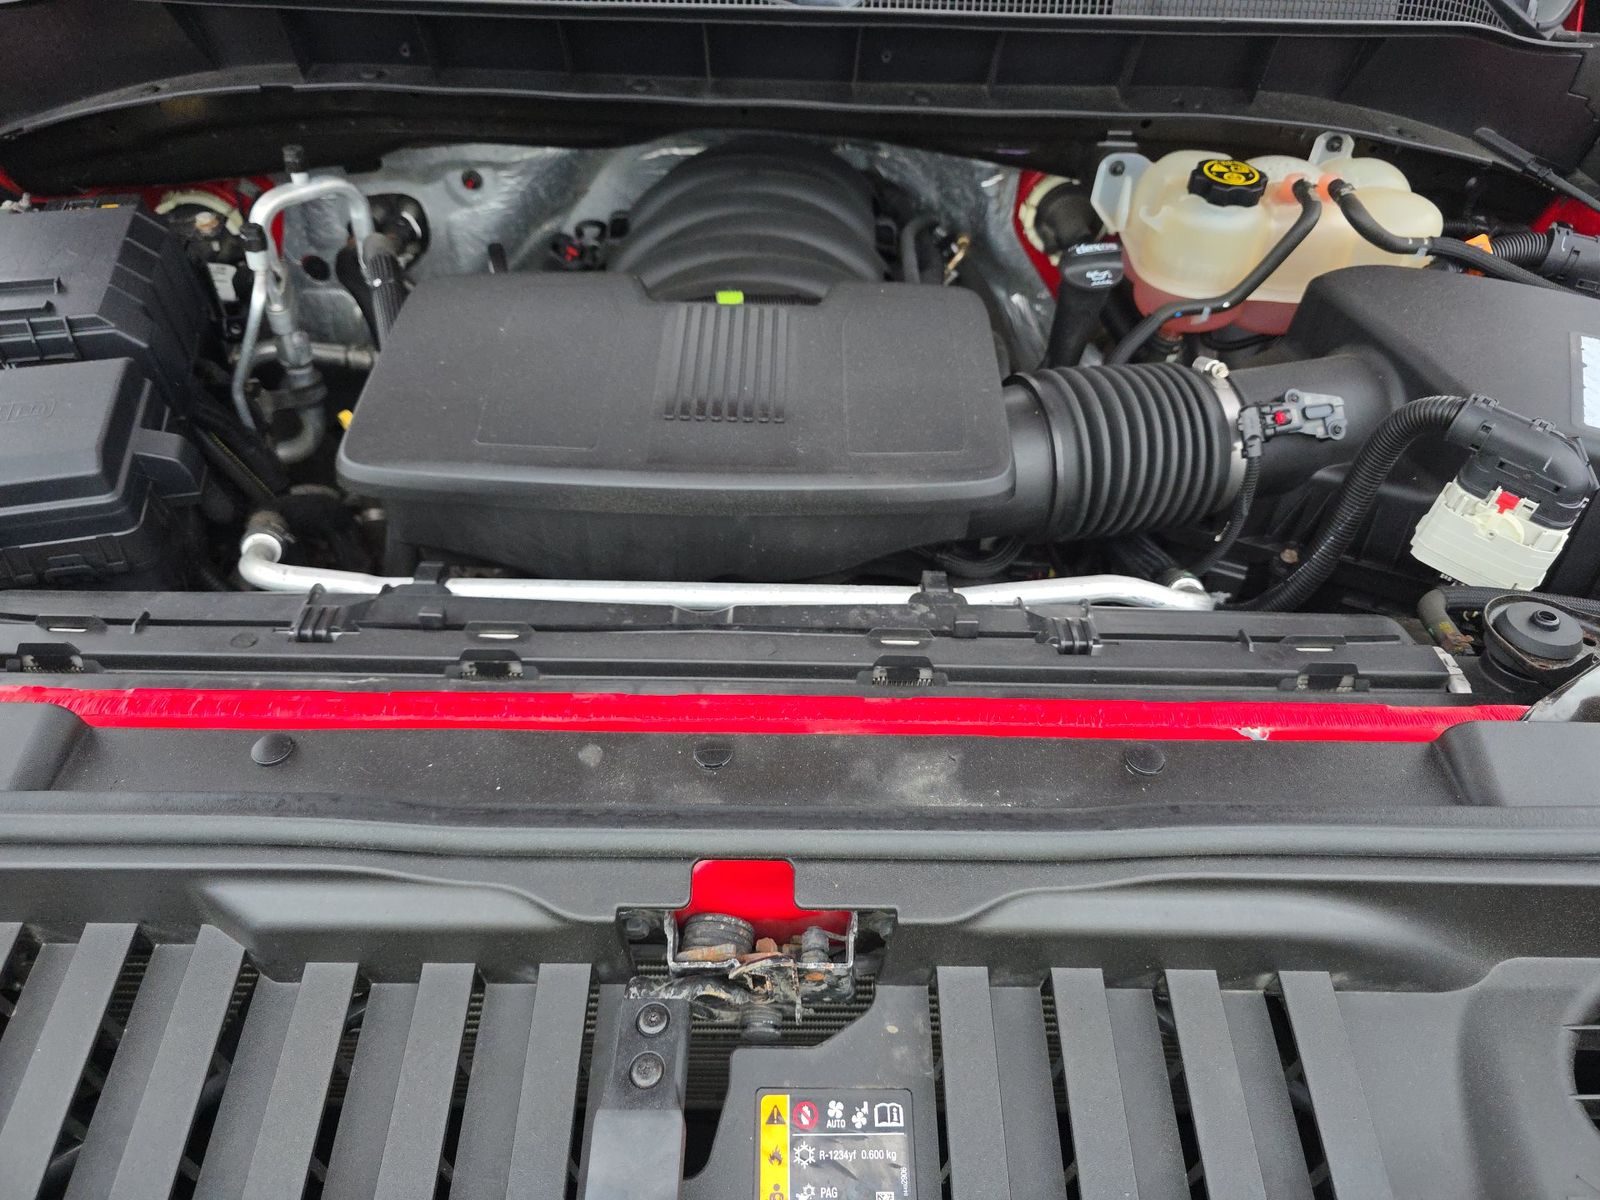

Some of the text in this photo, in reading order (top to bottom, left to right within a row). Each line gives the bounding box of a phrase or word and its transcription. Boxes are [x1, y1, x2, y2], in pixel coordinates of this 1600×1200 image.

[826, 1119, 846, 1128] AUTO
[819, 1149, 897, 1162] R-1234yf 0.600 kg
[820, 1187, 838, 1198] PAG
